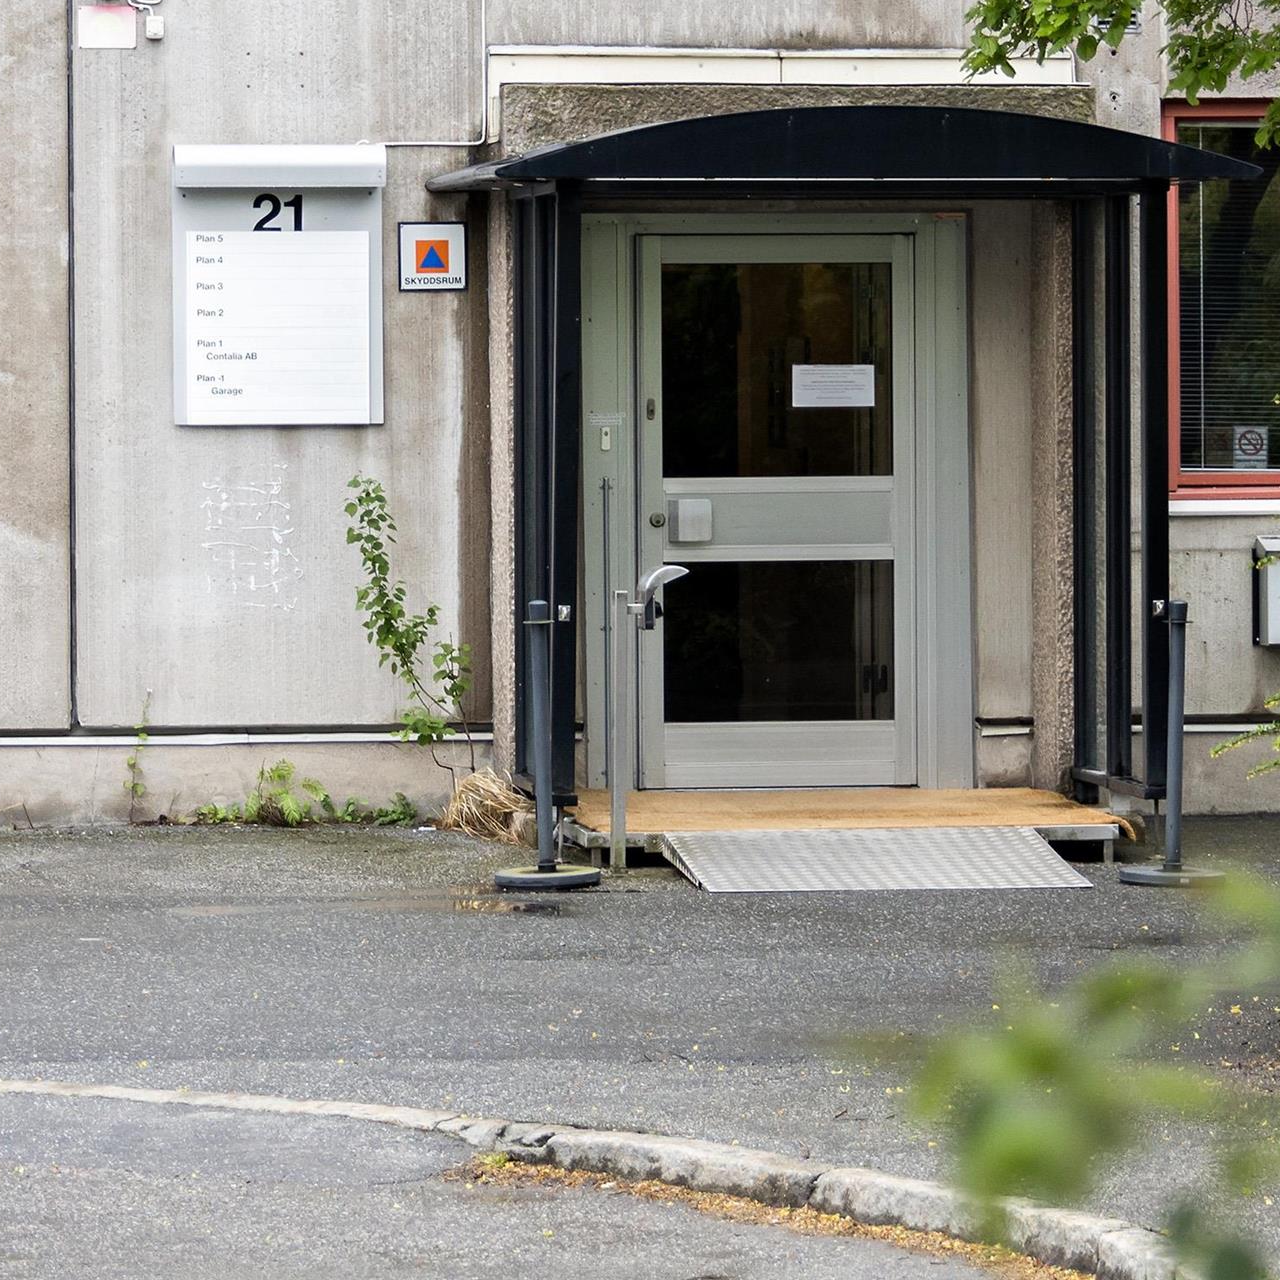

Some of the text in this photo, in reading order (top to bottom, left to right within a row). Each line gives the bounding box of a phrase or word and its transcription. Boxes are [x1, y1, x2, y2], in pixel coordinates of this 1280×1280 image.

[252, 193, 304, 232] 21
[195, 233, 216, 243] Plan
[195, 255, 216, 265] Plan
[404, 276, 462, 285] SKYDDSRUM
[196, 281, 216, 291] Plan
[196, 308, 217, 318] Plan
[196, 338, 217, 348] Plan
[206, 351, 258, 361] Contalia AB
[196, 373, 216, 383] Plan
[211, 386, 243, 398] Garage
